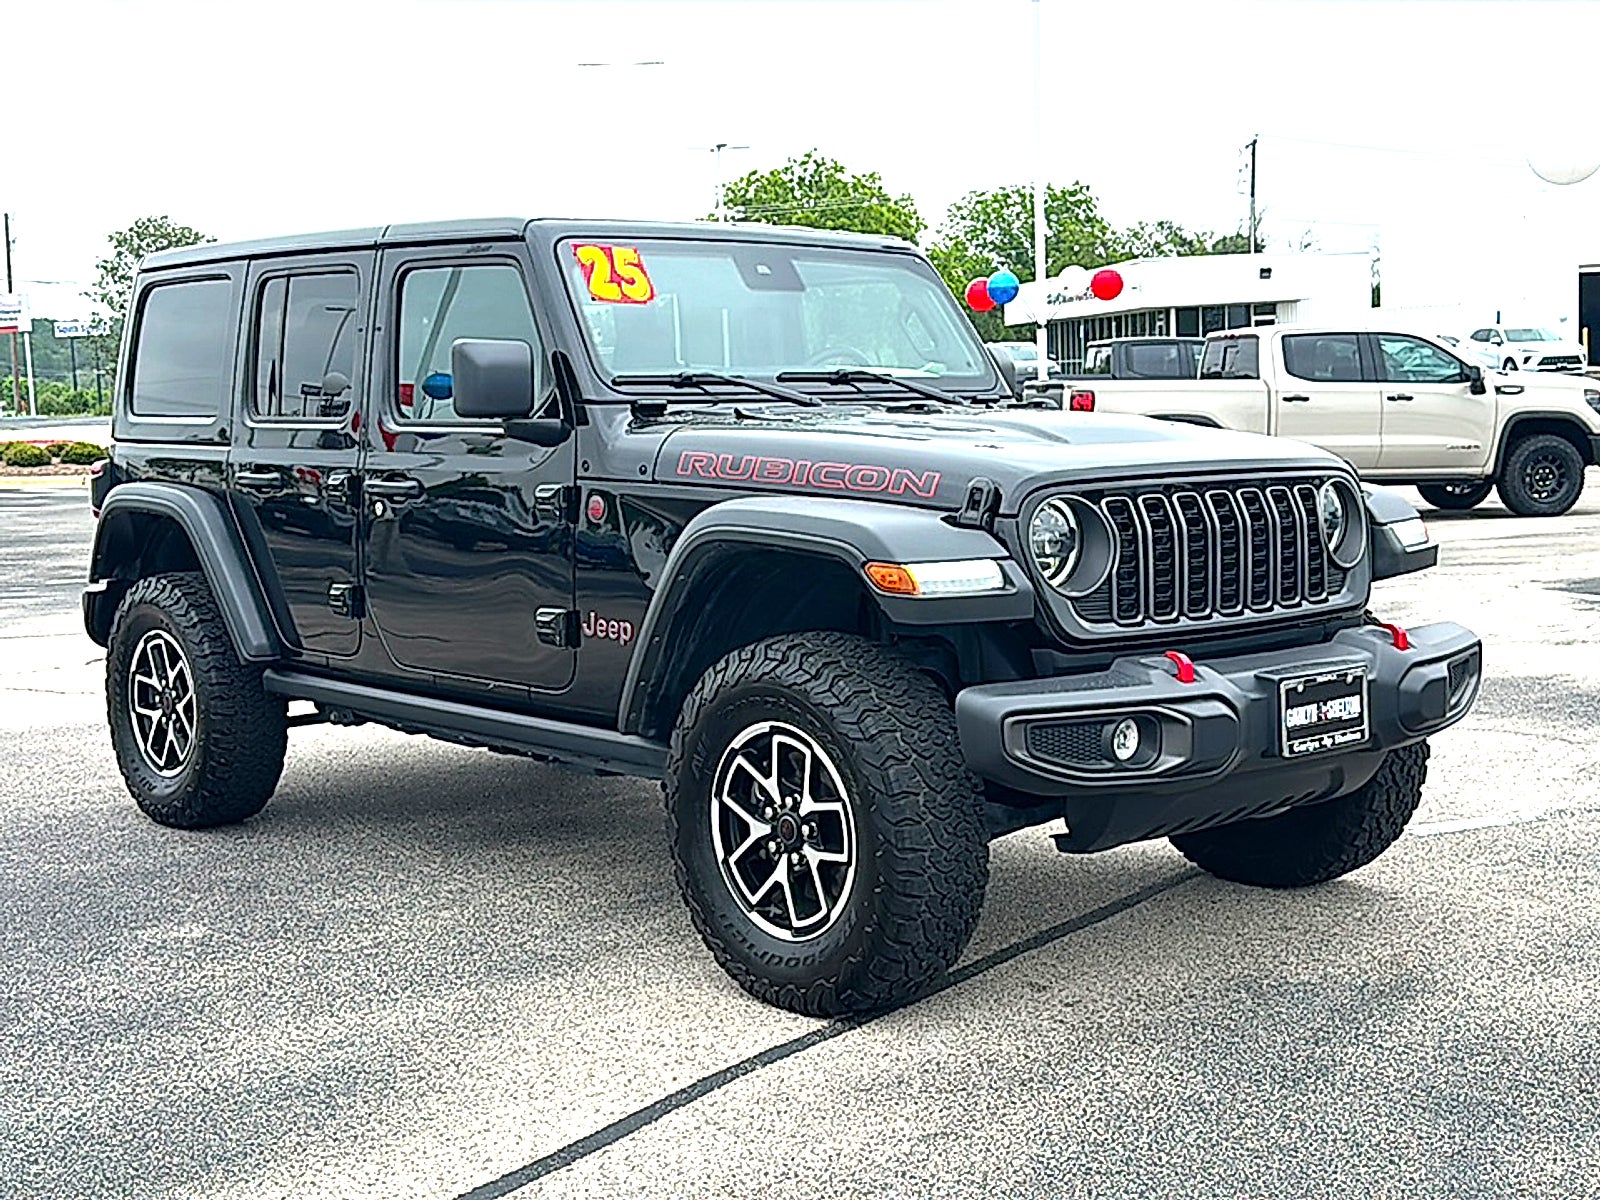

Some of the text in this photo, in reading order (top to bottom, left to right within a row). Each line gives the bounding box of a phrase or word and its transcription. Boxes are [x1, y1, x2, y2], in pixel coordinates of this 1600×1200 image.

[576, 245, 653, 302] 25
[676, 450, 941, 498] RUBICON
[582, 611, 634, 647] Jeep
